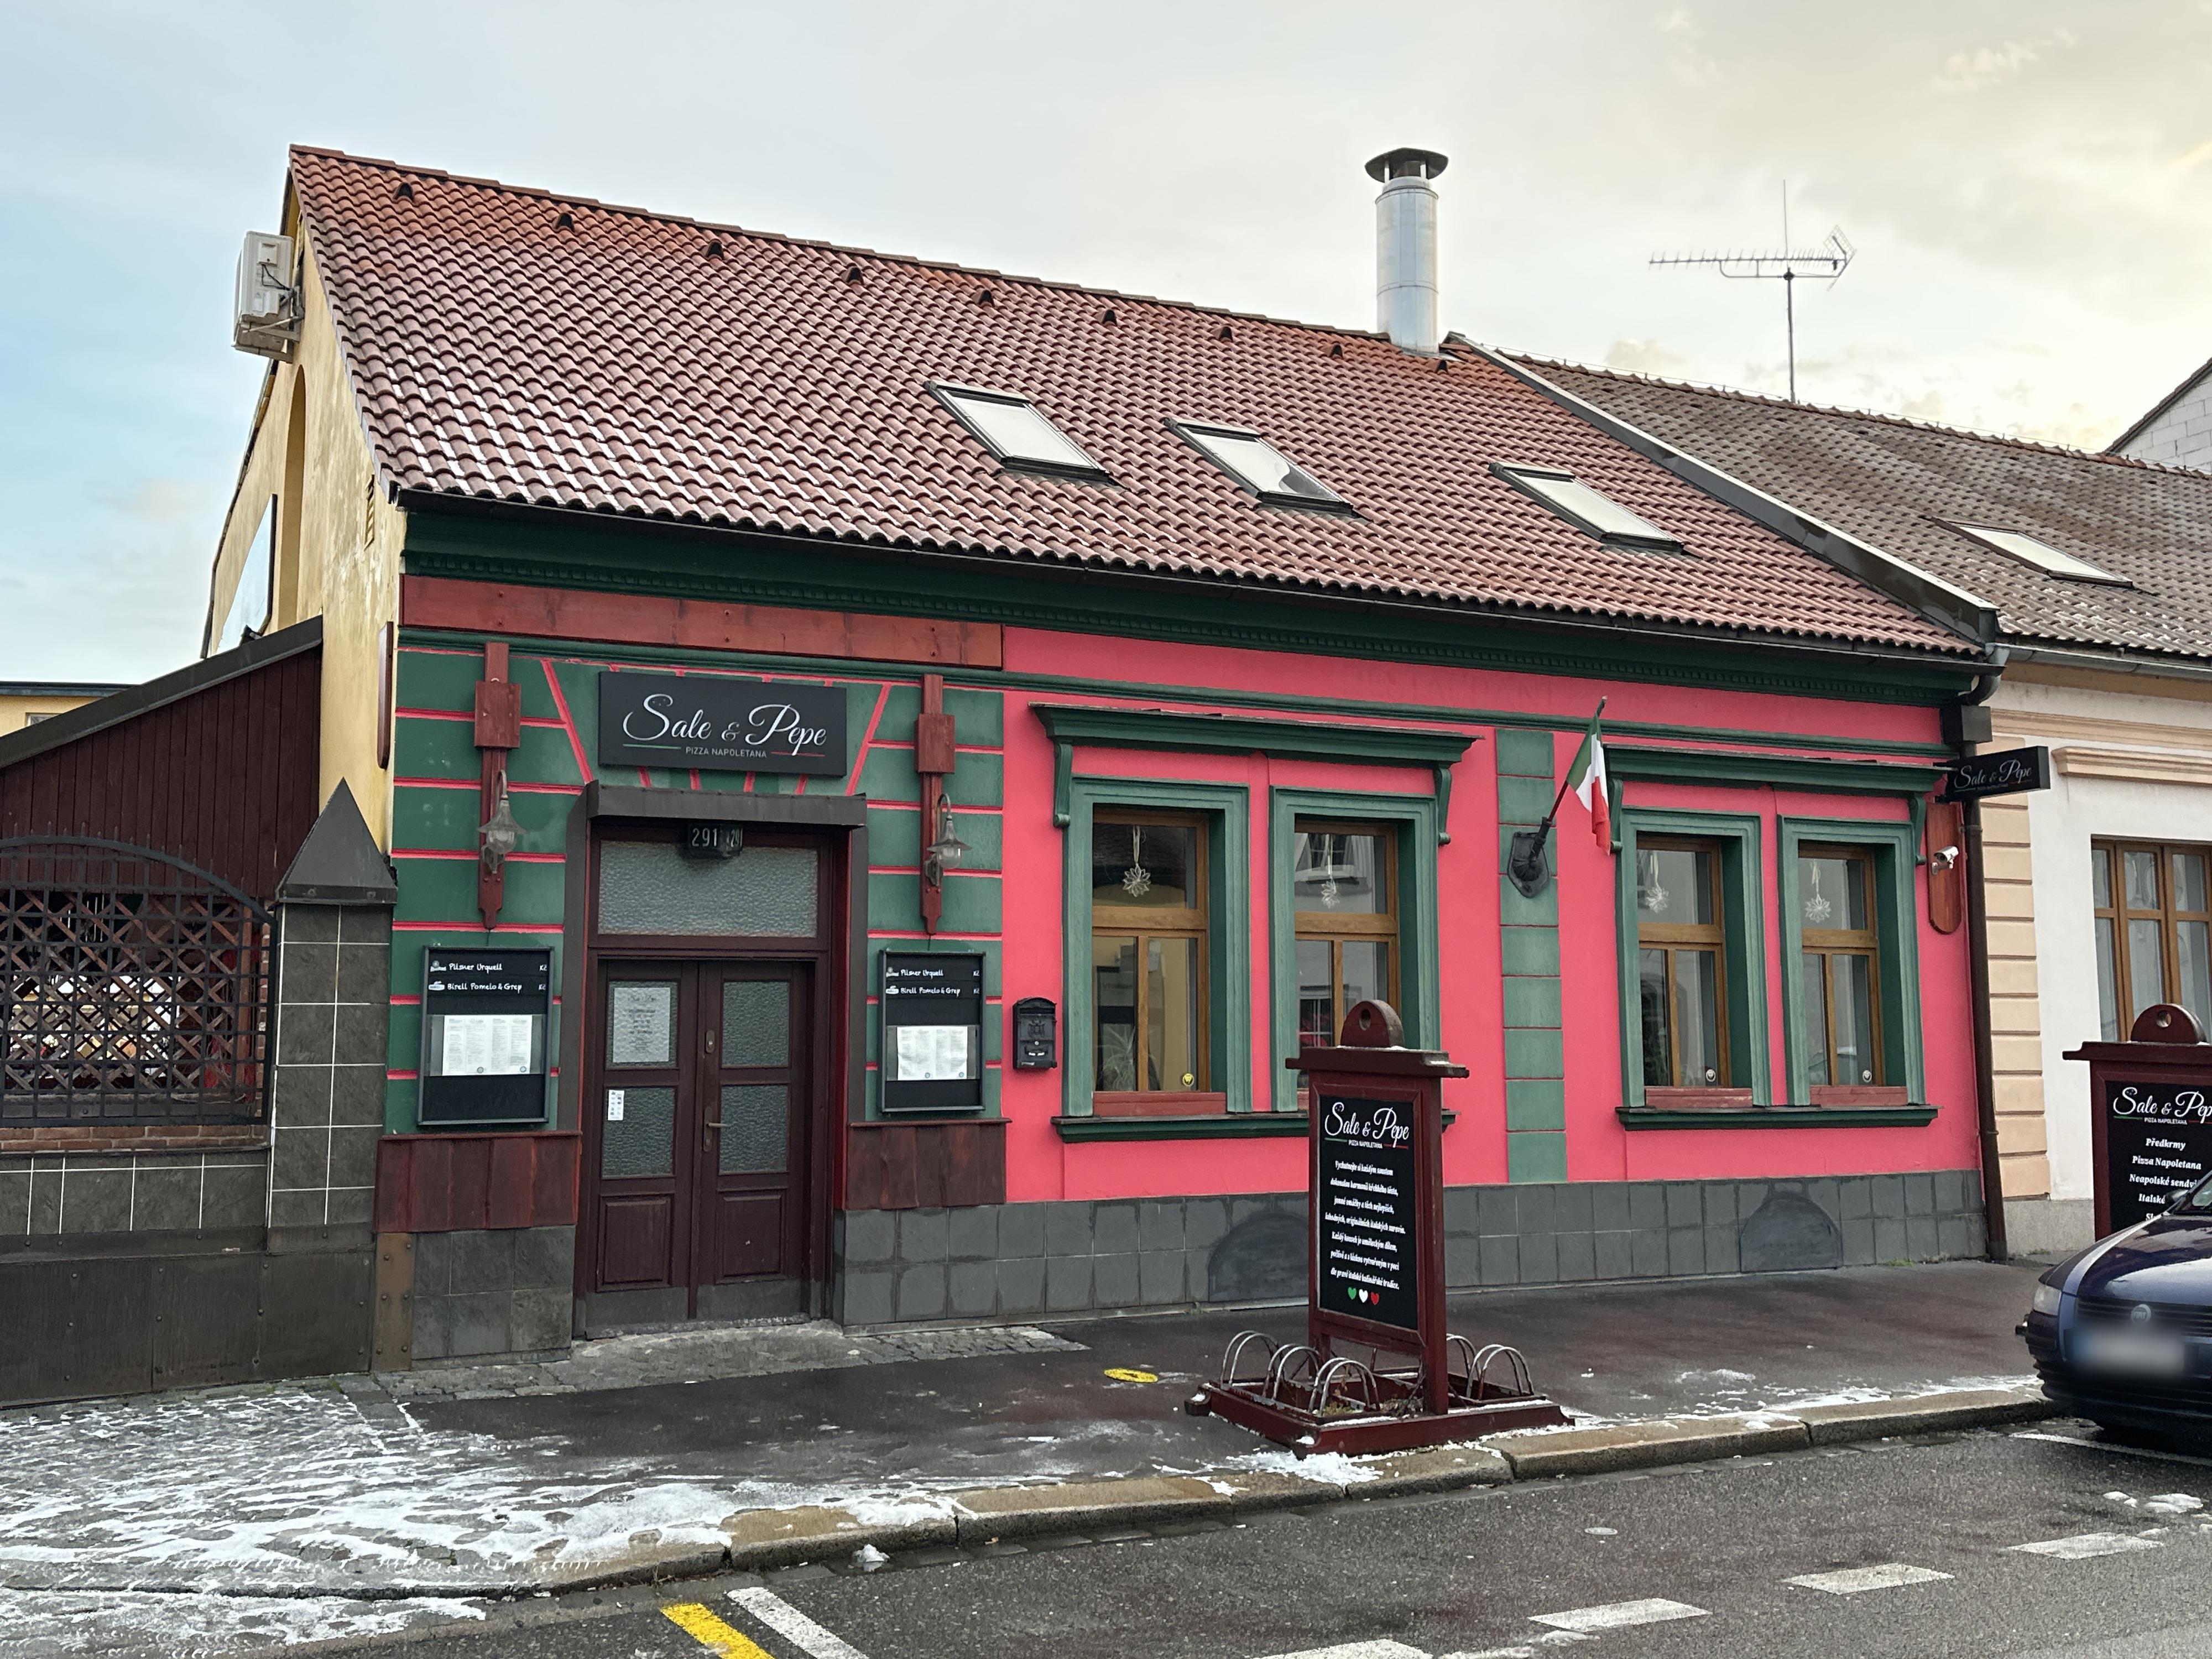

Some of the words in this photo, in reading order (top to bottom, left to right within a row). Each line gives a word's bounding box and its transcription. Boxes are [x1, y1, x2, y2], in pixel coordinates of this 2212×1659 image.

[622, 693, 712, 741] Sale
[721, 722, 740, 742] &
[745, 703, 827, 757] Pepe
[685, 746, 709, 755] PIZZA
[711, 748, 768, 758] NAPOLETANA
[1954, 764, 1985, 789] Sale
[1998, 758, 2032, 784] Pepe
[691, 827, 718, 847] 291
[448, 963, 475, 971] Pilsner
[476, 963, 503, 974] Urquell
[503, 983, 522, 994] Grep
[2112, 1087, 2158, 1115] Sale
[2161, 1103, 2172, 1115] &
[2174, 1091, 2212, 1124] Pep
[1324, 1101, 1359, 1136] Sale
[1362, 1121, 1371, 1137] &
[1372, 1107, 1410, 1148] Pepe
[2145, 1137, 2186, 1151] Předkrmy
[2132, 1155, 2154, 1165] Pizza
[2154, 1157, 2201, 1170] Napoletana
[2129, 1173, 2170, 1186] Neapolské
[2138, 1193, 2166, 1204] Italské
